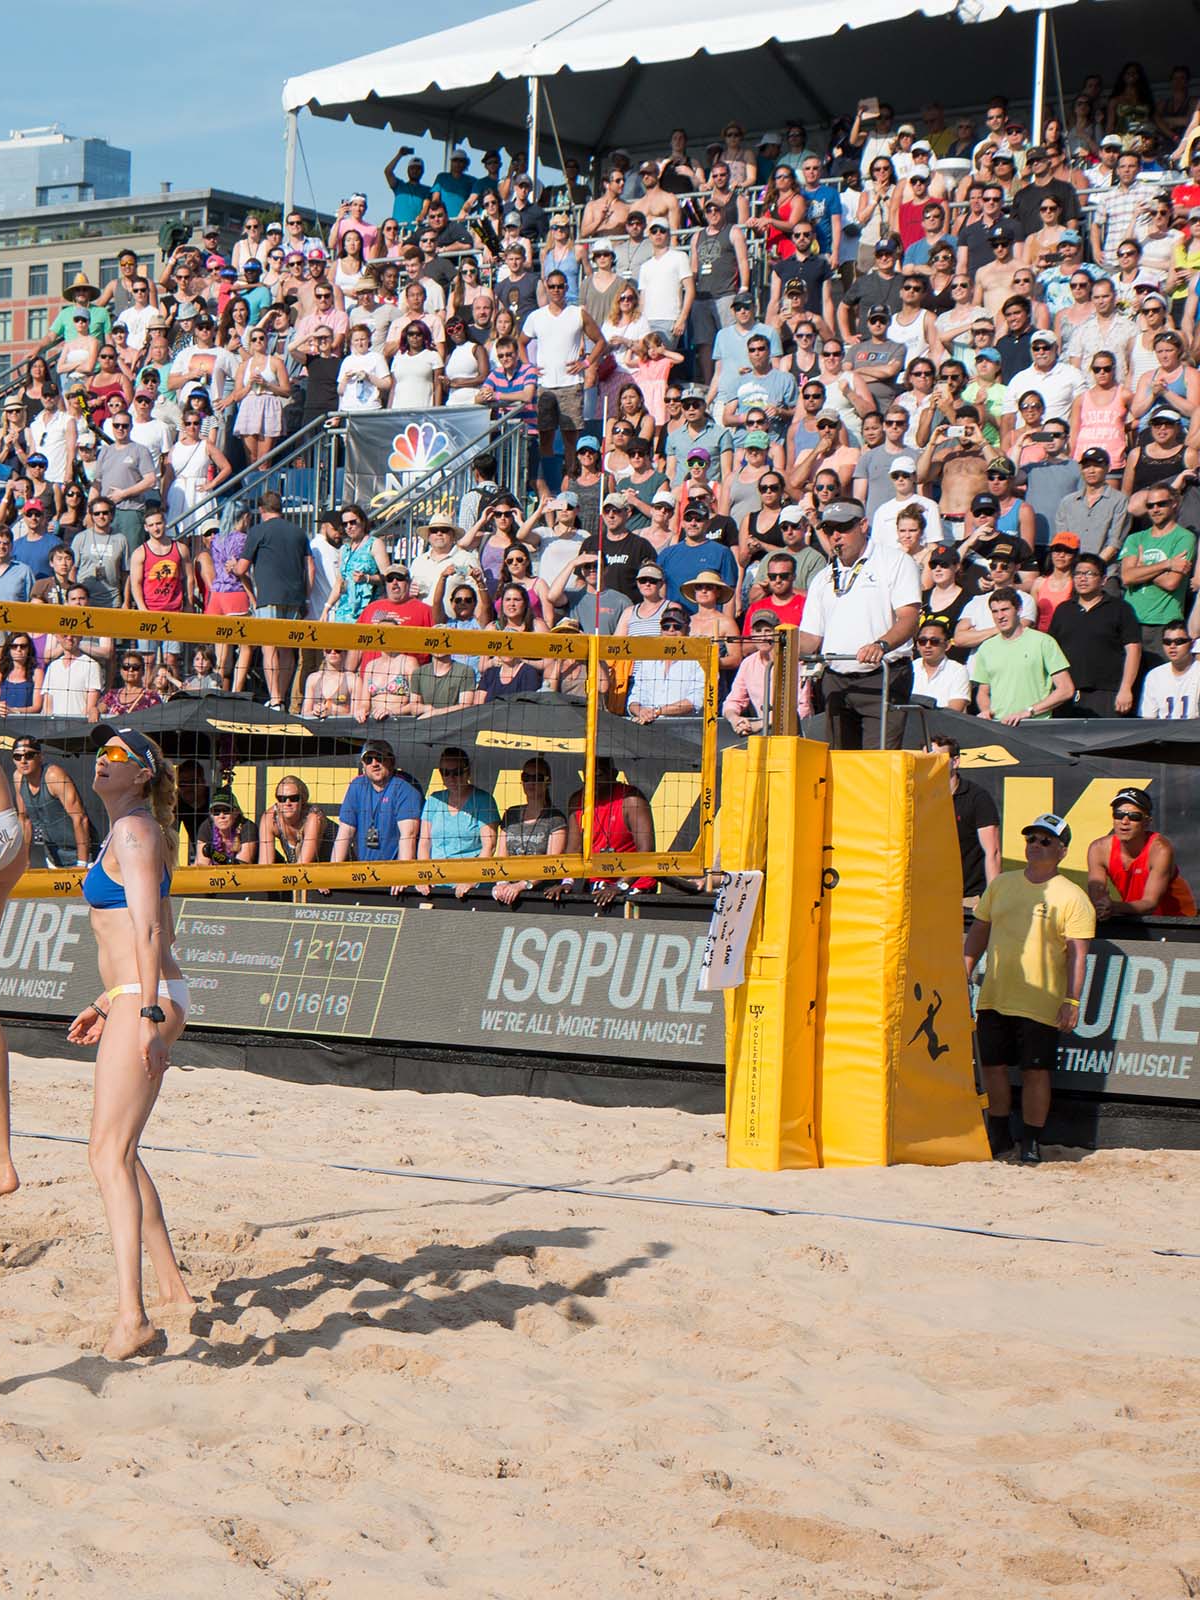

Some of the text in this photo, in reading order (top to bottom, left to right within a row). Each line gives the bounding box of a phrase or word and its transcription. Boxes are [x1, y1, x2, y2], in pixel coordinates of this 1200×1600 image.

[59, 616, 79, 630] avp
[139, 621, 158, 635] avp
[215, 626, 233, 639] avp
[288, 630, 305, 643] avp
[357, 634, 374, 646] avp
[424, 637, 440, 649] avp
[486, 640, 503, 651] avp
[548, 642, 564, 653] avp
[607, 644, 622, 656] avp
[663, 643, 677, 656] avp
[484, 738, 532, 748] avp
[542, 864, 558, 876] avp
[601, 862, 615, 873] avp
[657, 860, 670, 872] avp
[351, 871, 367, 884] avp
[417, 869, 433, 882] avp
[481, 867, 497, 880] avp
[53, 880, 72, 894] avp
[209, 876, 226, 888] avp
[282, 874, 298, 887] avp
[295, 908, 400, 924] WON SET1 SET2 SET3
[191, 920, 225, 936] Ross
[185, 948, 227, 963] Walsh
[293, 939, 304, 959] 1
[307, 939, 335, 961] 21
[335, 940, 364, 962] 20
[487, 926, 714, 1014] ISOPURE
[17, 980, 68, 1000] MUSCLE
[274, 991, 291, 1012] 0
[297, 992, 321, 1014] 16
[325, 994, 350, 1016] 18
[480, 1009, 707, 1045] WE'RE ALL MORE THAN MUSCLE
[1065, 1047, 1114, 1074] THAN
[1115, 1052, 1194, 1080] MUSCLE
